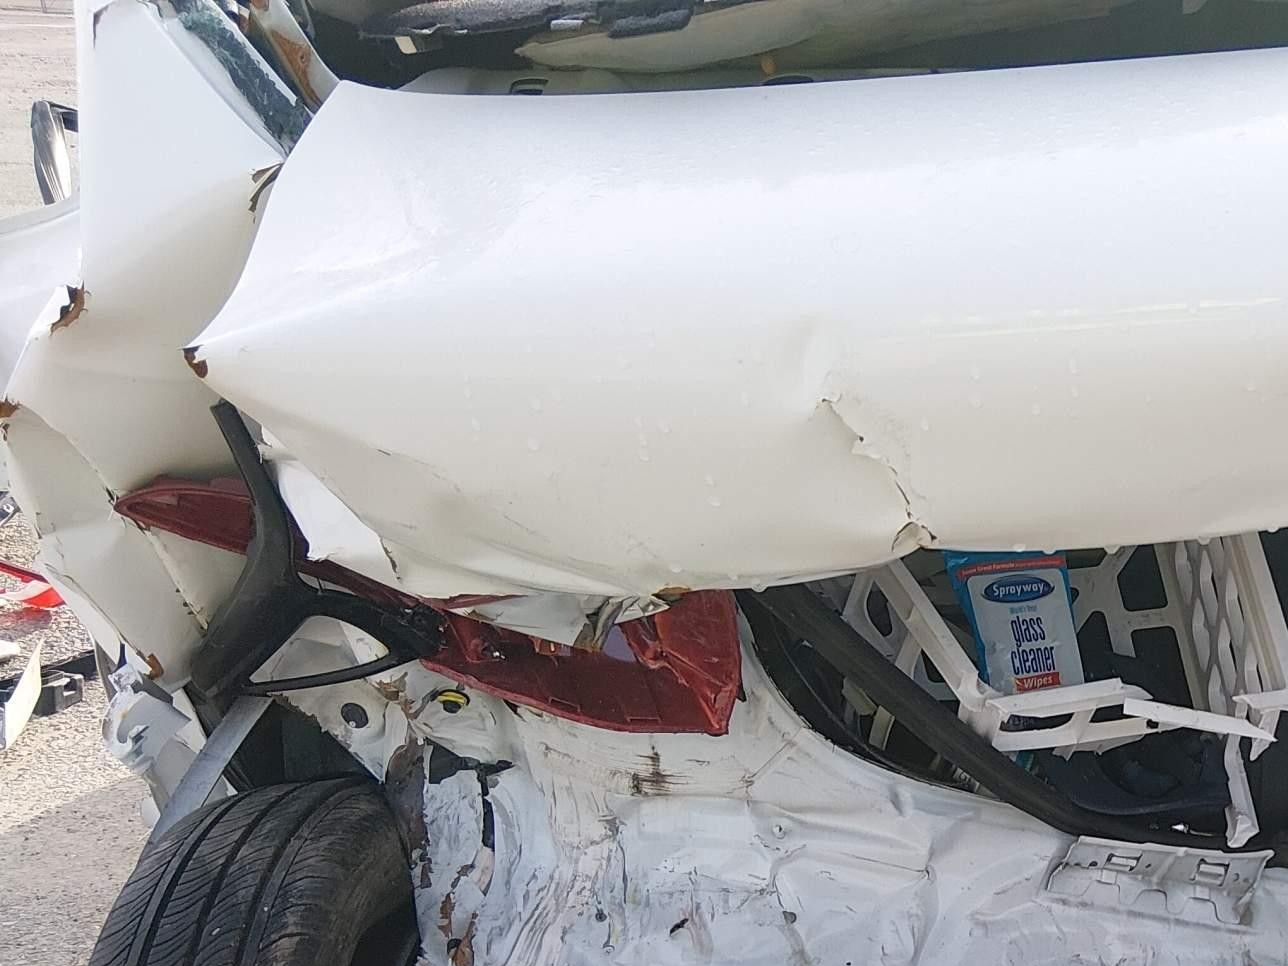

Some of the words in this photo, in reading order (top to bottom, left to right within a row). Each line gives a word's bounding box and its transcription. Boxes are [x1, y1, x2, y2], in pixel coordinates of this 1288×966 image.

[992, 582, 1045, 598] Sprayway
[1010, 616, 1046, 647] glass
[1010, 645, 1056, 675] cleaner
[1023, 675, 1053, 690] Wipes
